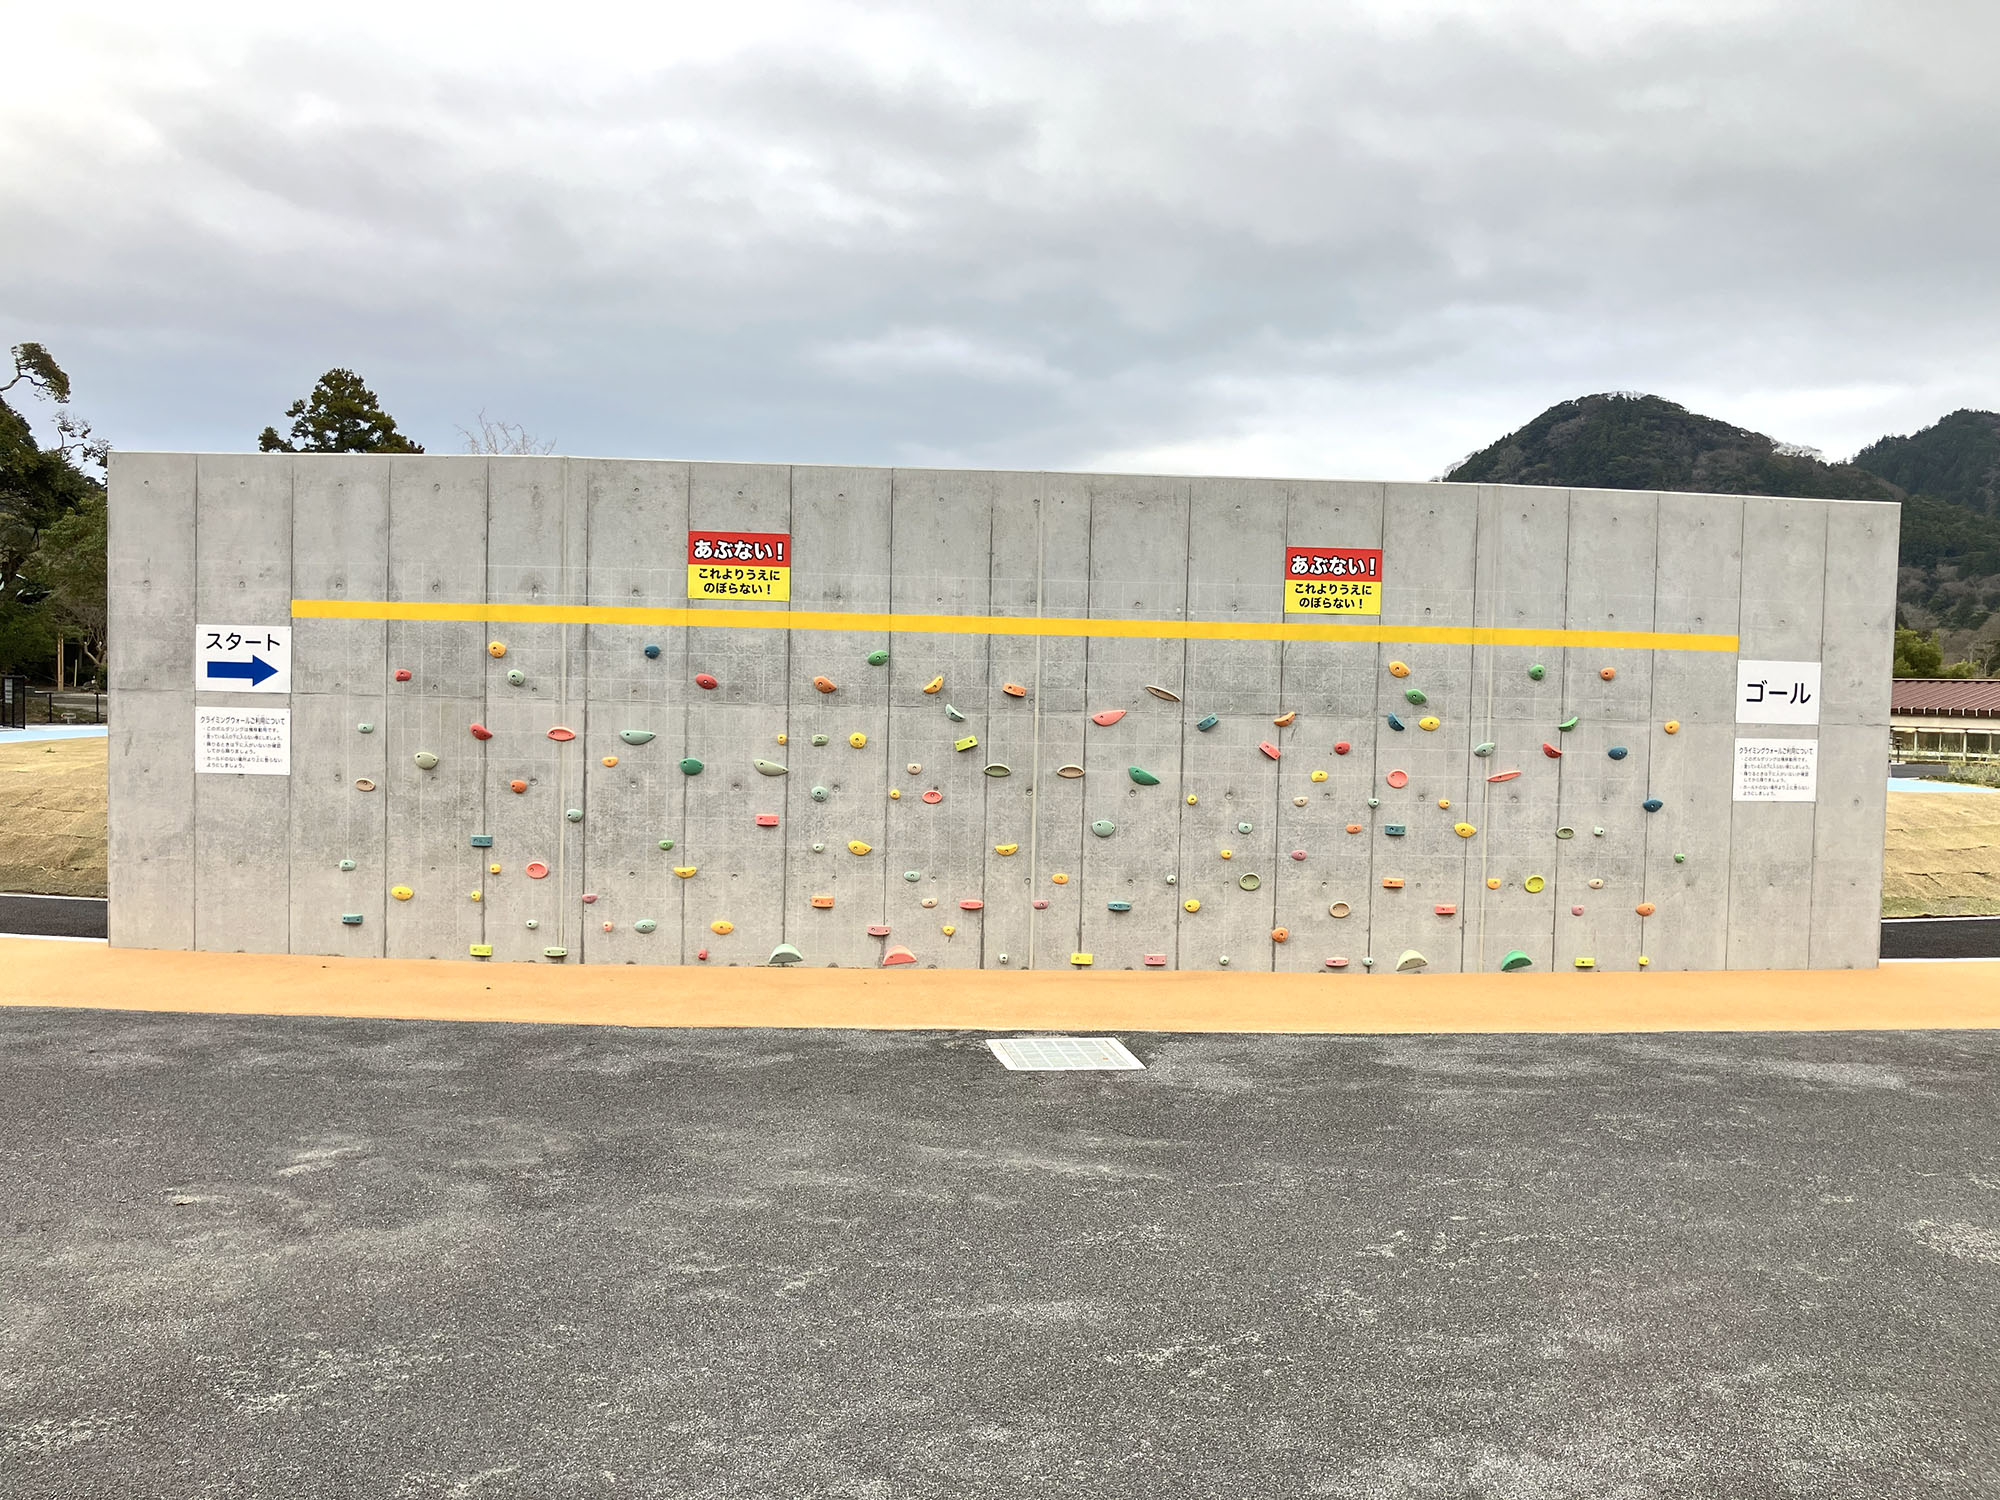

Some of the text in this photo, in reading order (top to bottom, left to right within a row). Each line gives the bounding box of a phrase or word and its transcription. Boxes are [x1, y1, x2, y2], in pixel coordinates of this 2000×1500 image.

[694, 539, 784, 561] あぶない！
[1290, 554, 1377, 576] あぶない！
[699, 568, 780, 581] これよりうえに
[704, 582, 771, 595] のぼらない！
[1294, 583, 1372, 595] これよりうえに
[1299, 597, 1363, 609] のぼらない！
[206, 632, 281, 651] スタート
[1746, 680, 1811, 704] ゴール
